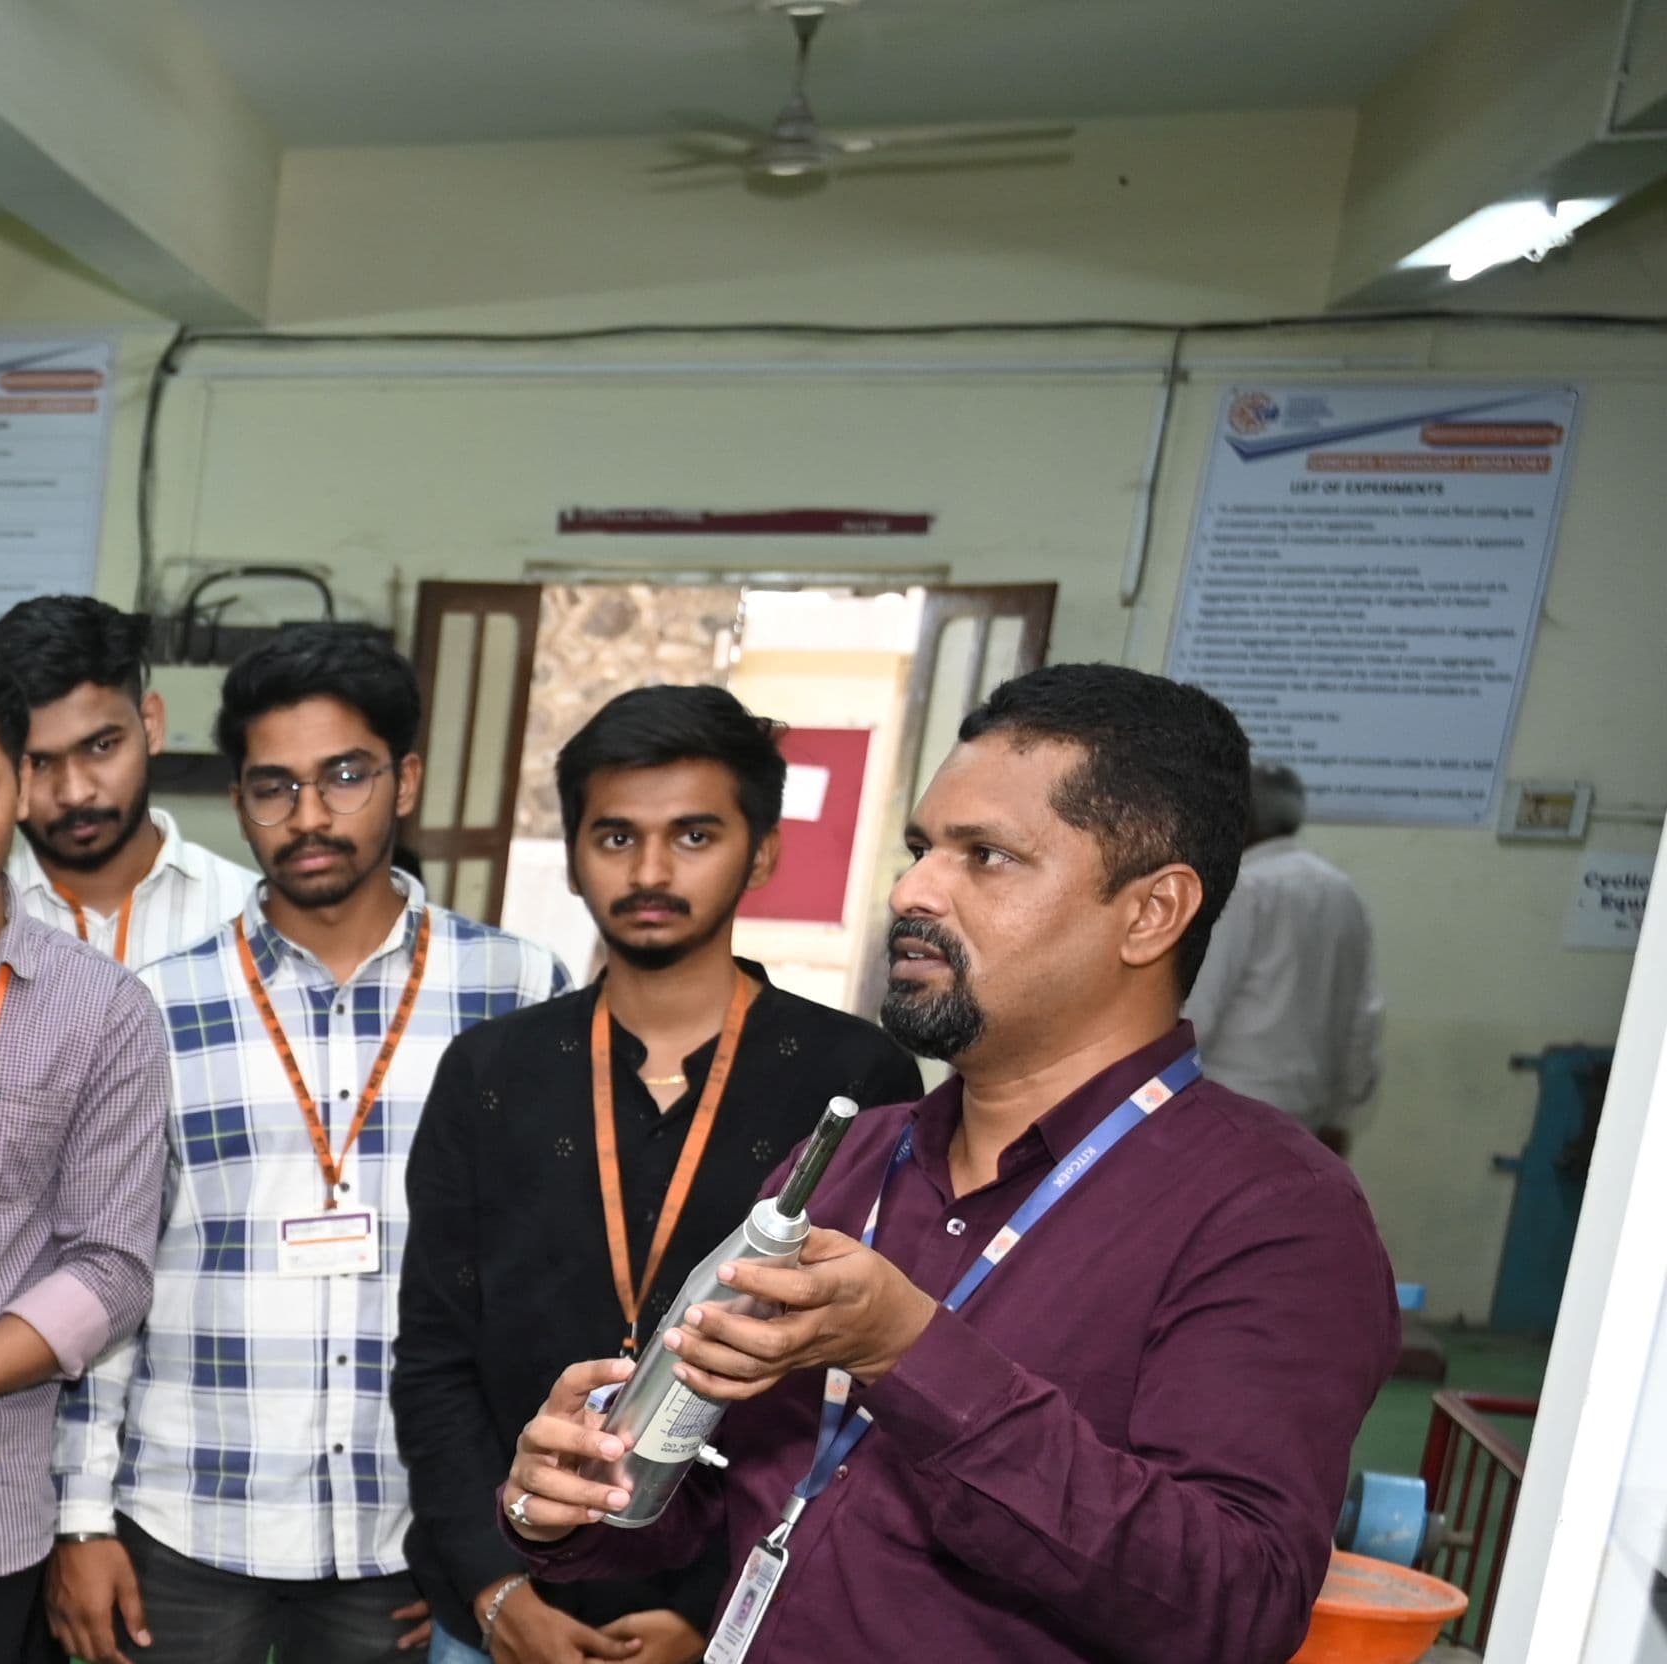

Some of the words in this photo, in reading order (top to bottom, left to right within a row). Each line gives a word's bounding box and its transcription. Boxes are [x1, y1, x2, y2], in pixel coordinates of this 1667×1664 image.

[1289, 480, 1320, 495] LIST
[1322, 480, 1341, 495] OF
[1345, 481, 1445, 496] EXPERIMENTS
[1052, 1145, 1097, 1189] KITCoEK
